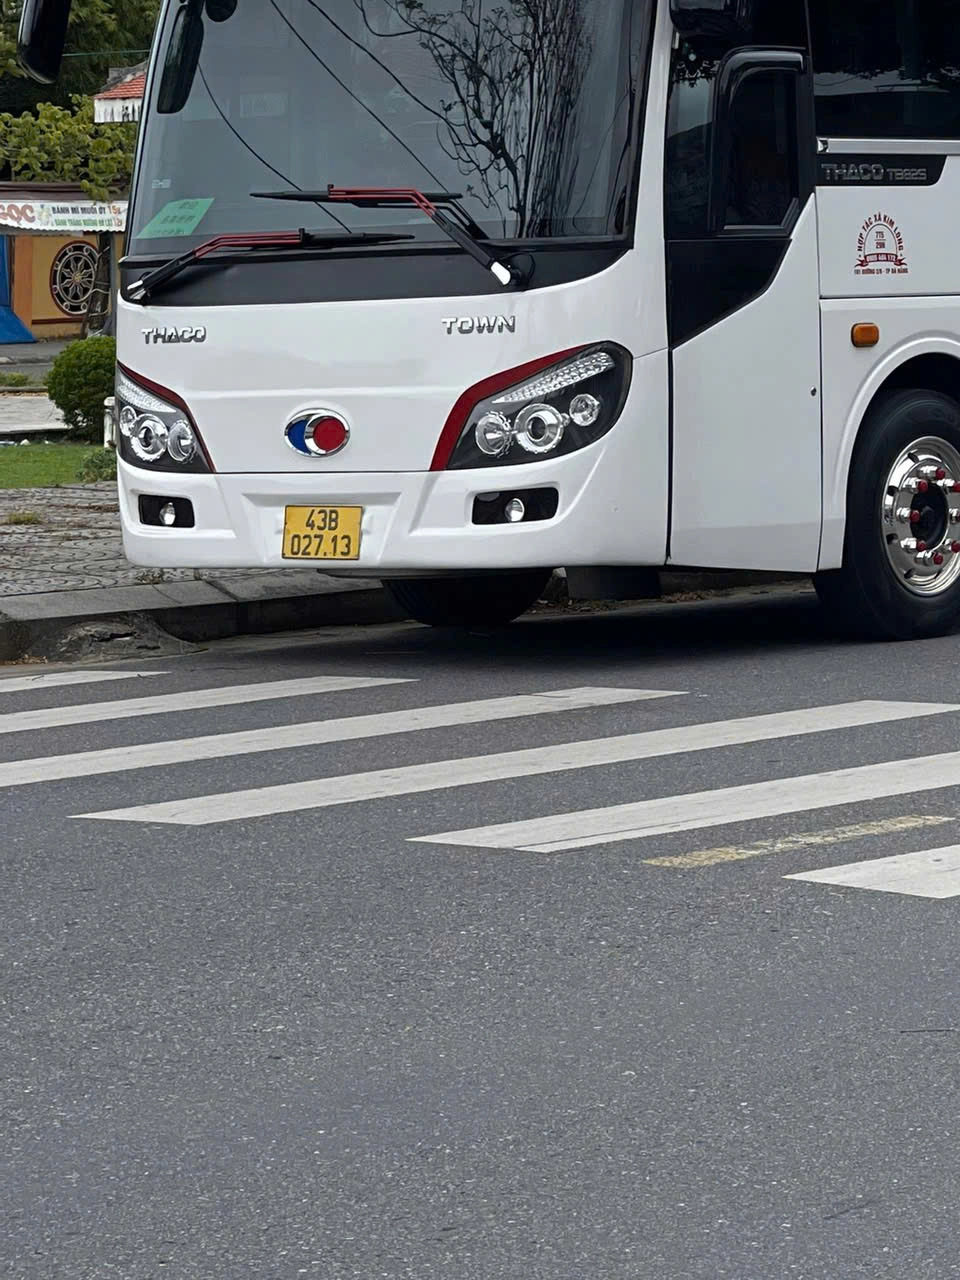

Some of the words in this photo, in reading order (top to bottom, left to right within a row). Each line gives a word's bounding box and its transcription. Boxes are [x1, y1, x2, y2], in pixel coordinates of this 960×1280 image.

[821, 163, 884, 180] THACO
[883, 214, 895, 229] KIM
[893, 226, 904, 251] LONG
[141, 326, 207, 344] THACO
[441, 316, 516, 335] TOWN
[305, 509, 339, 531] 43B
[290, 534, 352, 556] 027.13
